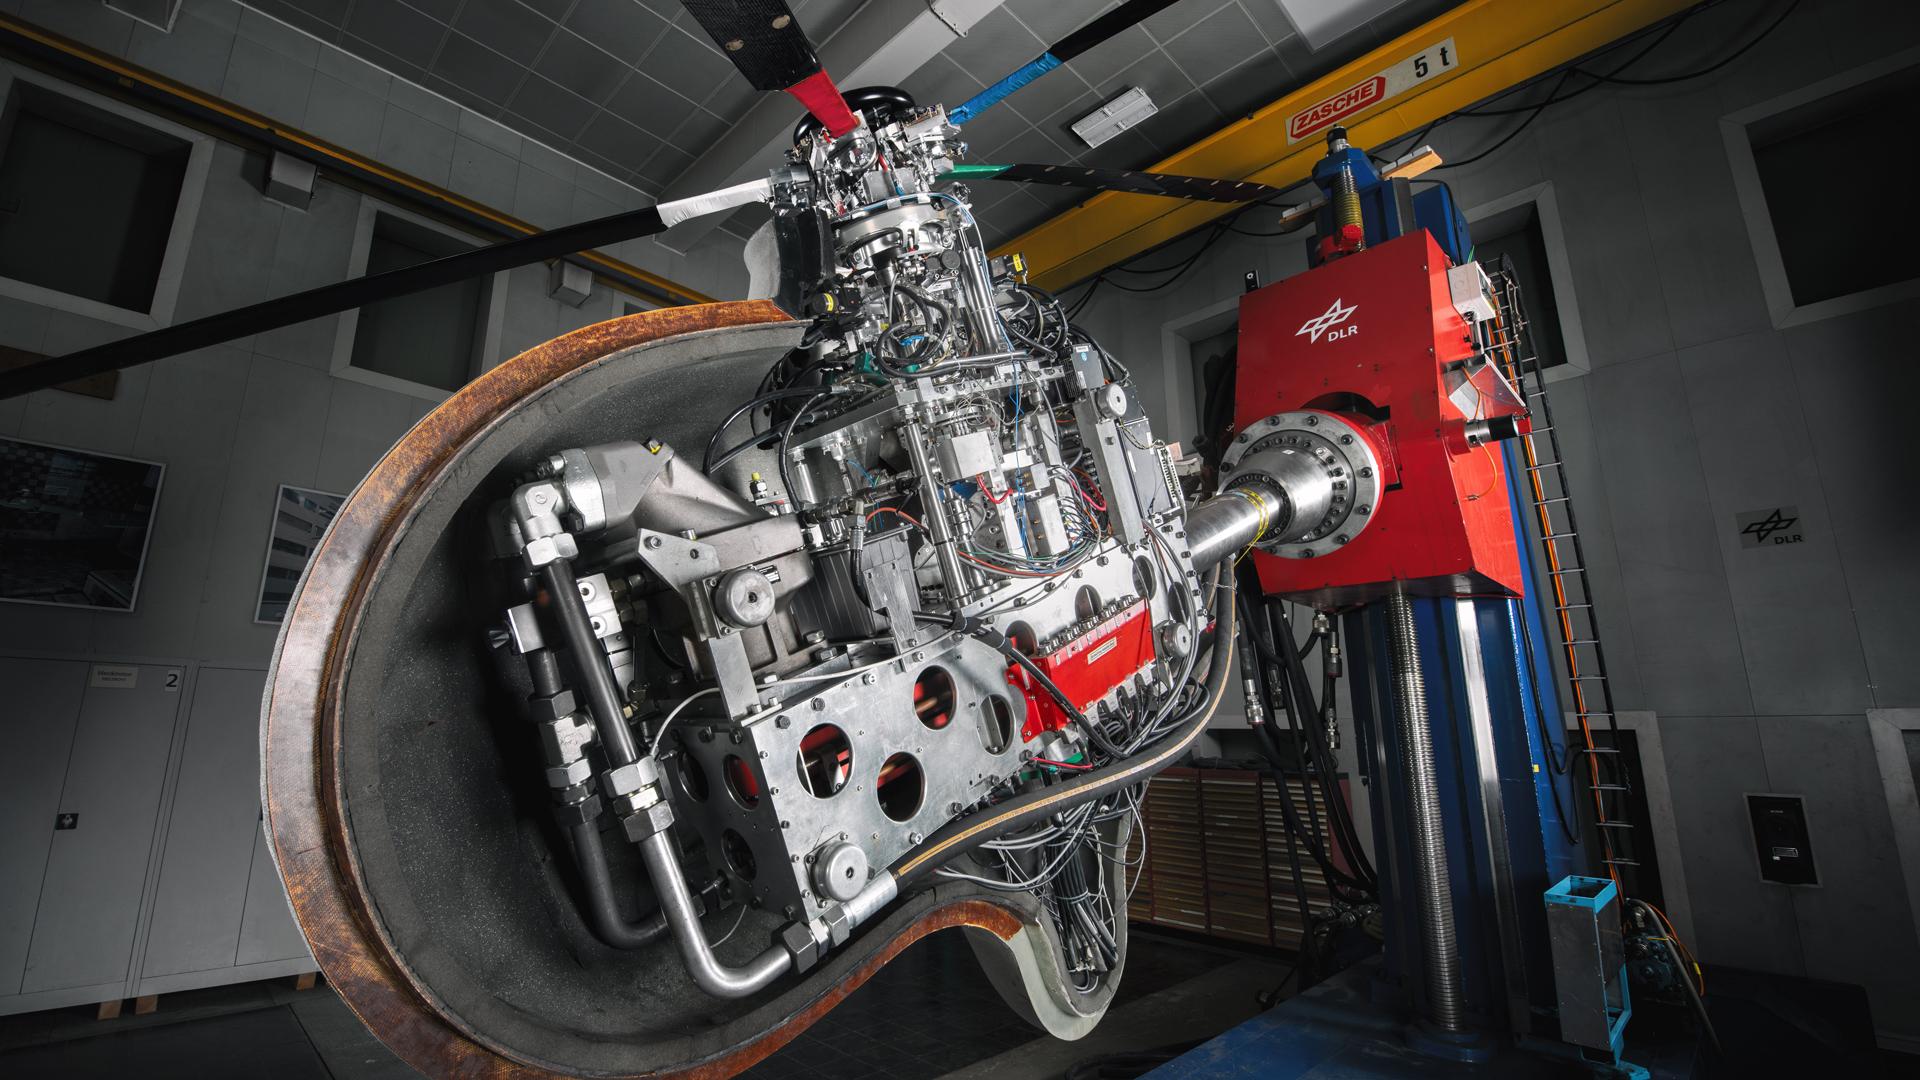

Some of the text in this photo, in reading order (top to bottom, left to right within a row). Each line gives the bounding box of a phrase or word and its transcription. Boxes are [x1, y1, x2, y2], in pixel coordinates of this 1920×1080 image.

[1414, 46, 1450, 78] 5 t
[1296, 81, 1374, 131] ZASCHE
[1328, 325, 1358, 342] DLR
[1774, 534, 1803, 545] DLR
[165, 673, 178, 687] 2
